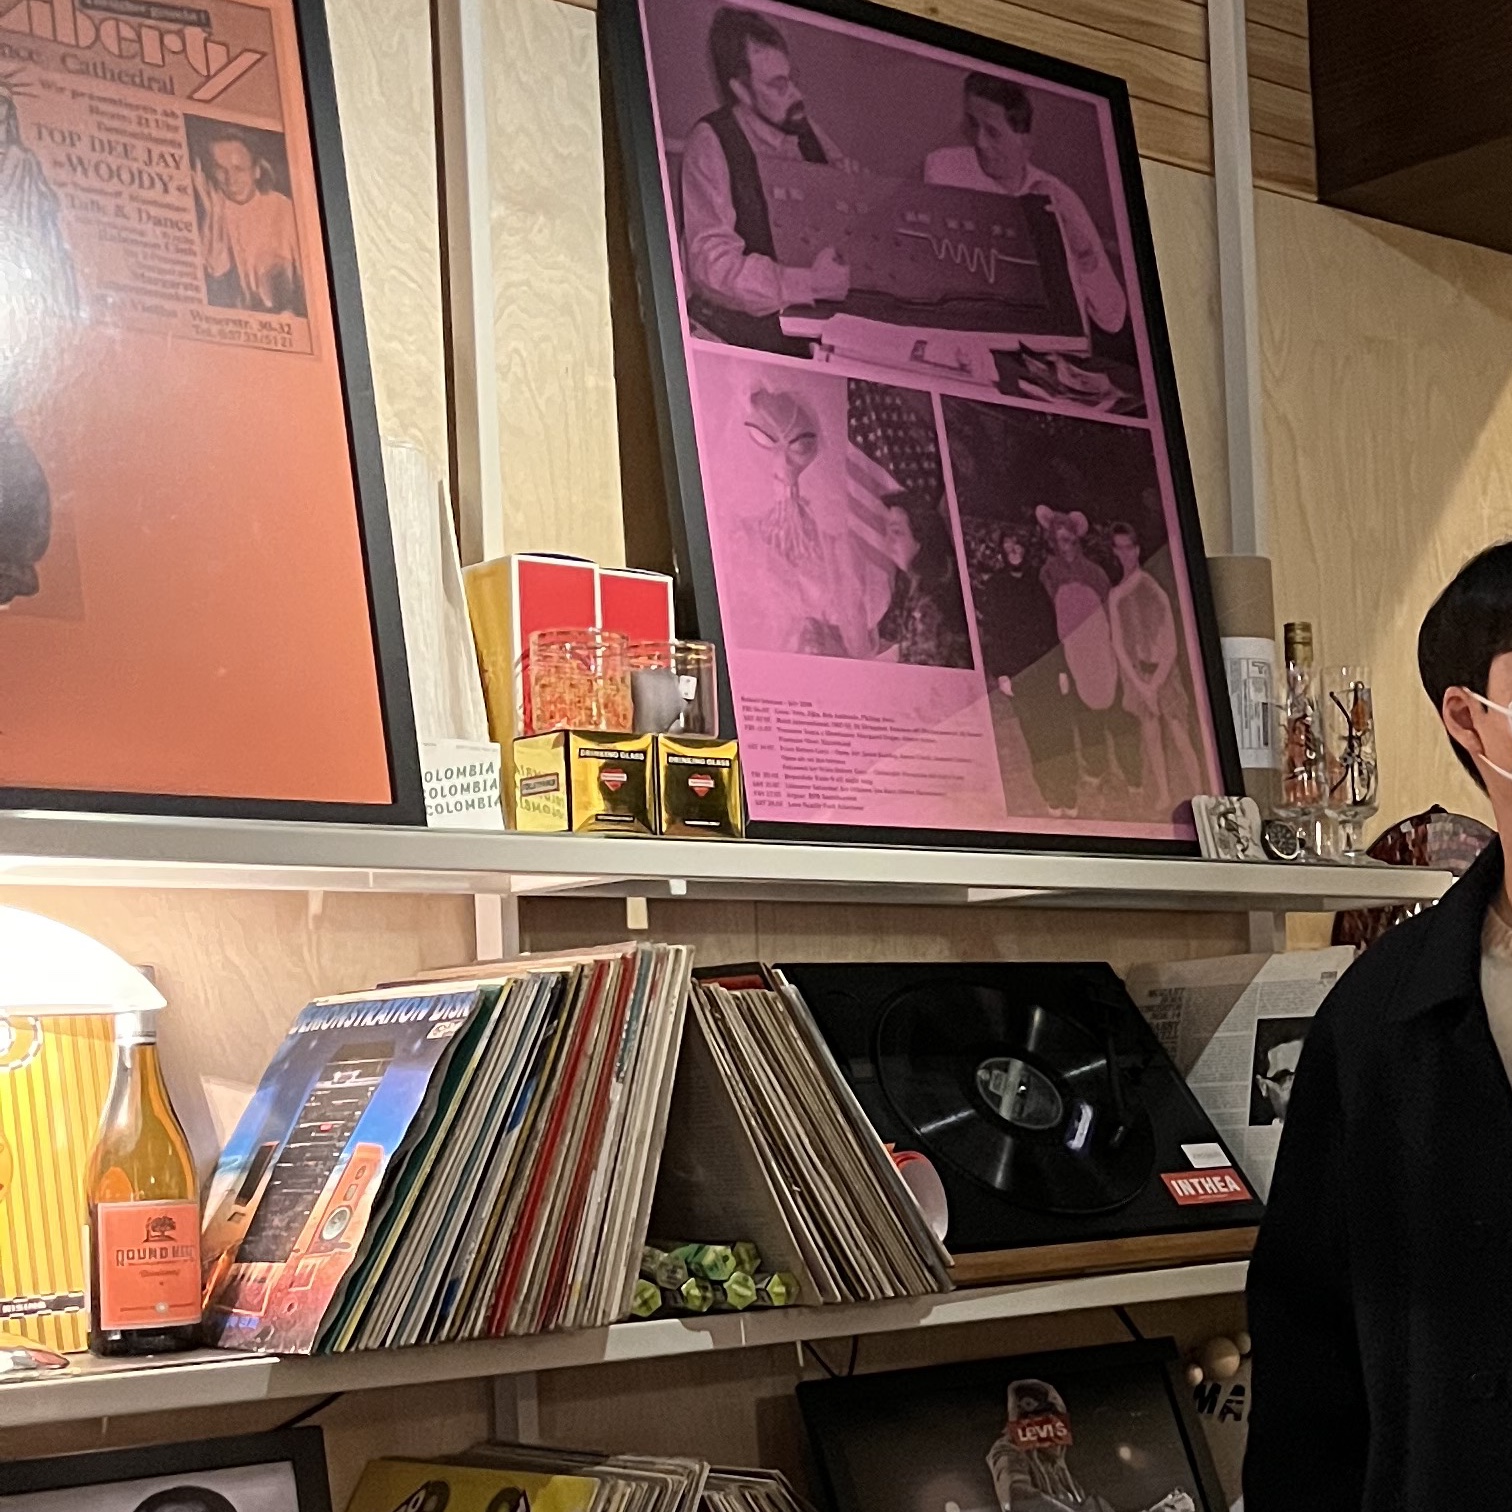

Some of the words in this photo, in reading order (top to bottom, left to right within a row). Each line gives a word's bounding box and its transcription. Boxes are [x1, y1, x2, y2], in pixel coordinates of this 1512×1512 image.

[61, 53, 176, 96] Cathedral
[34, 122, 81, 148] TOP
[90, 135, 139, 161] DEE
[143, 147, 184, 170] JAY
[137, 207, 193, 234] Dance
[424, 762, 495, 784] OLOMBIA
[423, 778, 498, 800] OLOMBIA
[116, 1246, 169, 1267] ROUND
